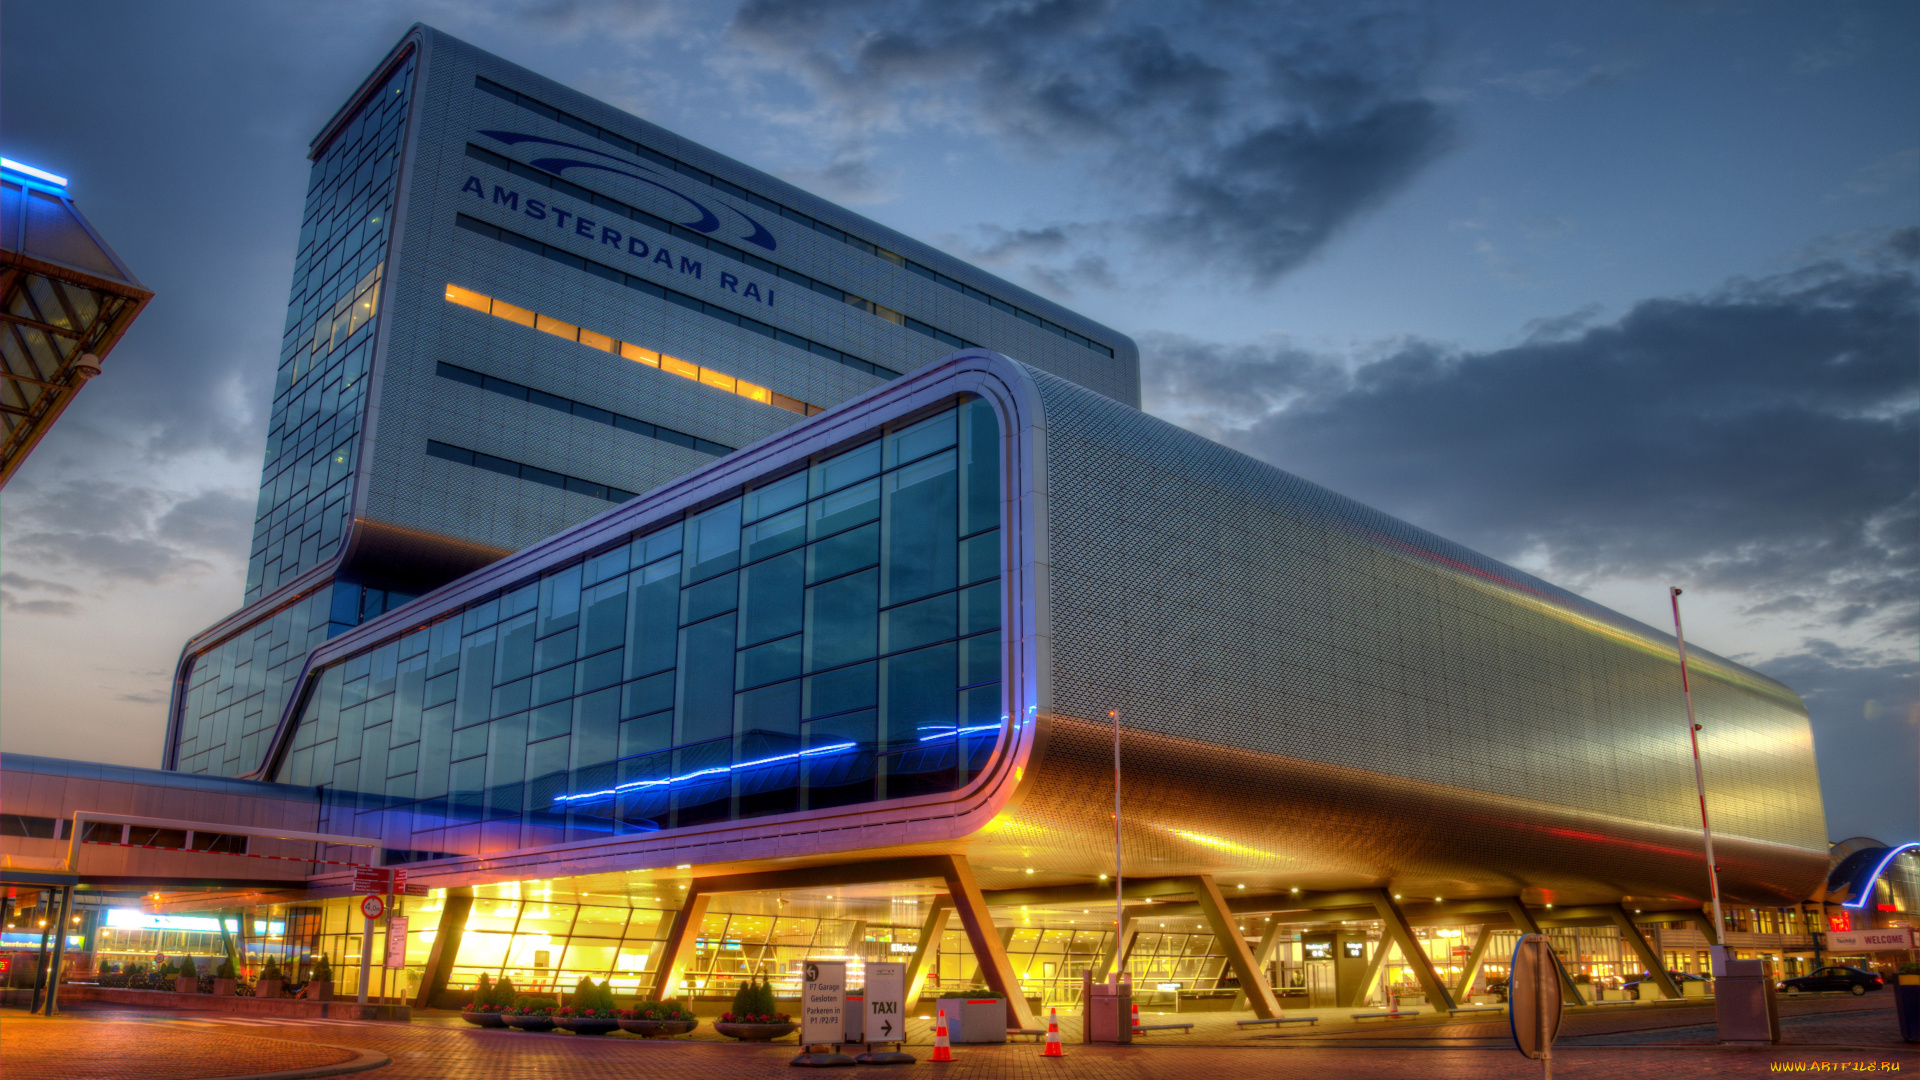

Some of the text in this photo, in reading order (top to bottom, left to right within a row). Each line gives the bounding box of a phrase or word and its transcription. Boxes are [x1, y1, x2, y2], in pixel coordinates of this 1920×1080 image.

[461, 175, 776, 308] AMSTERDAM RAI
[1864, 935, 1904, 944] WELCOME
[818, 983, 840, 992] Garage
[834, 1006, 841, 1014] in
[872, 1001, 897, 1014] TAXI
